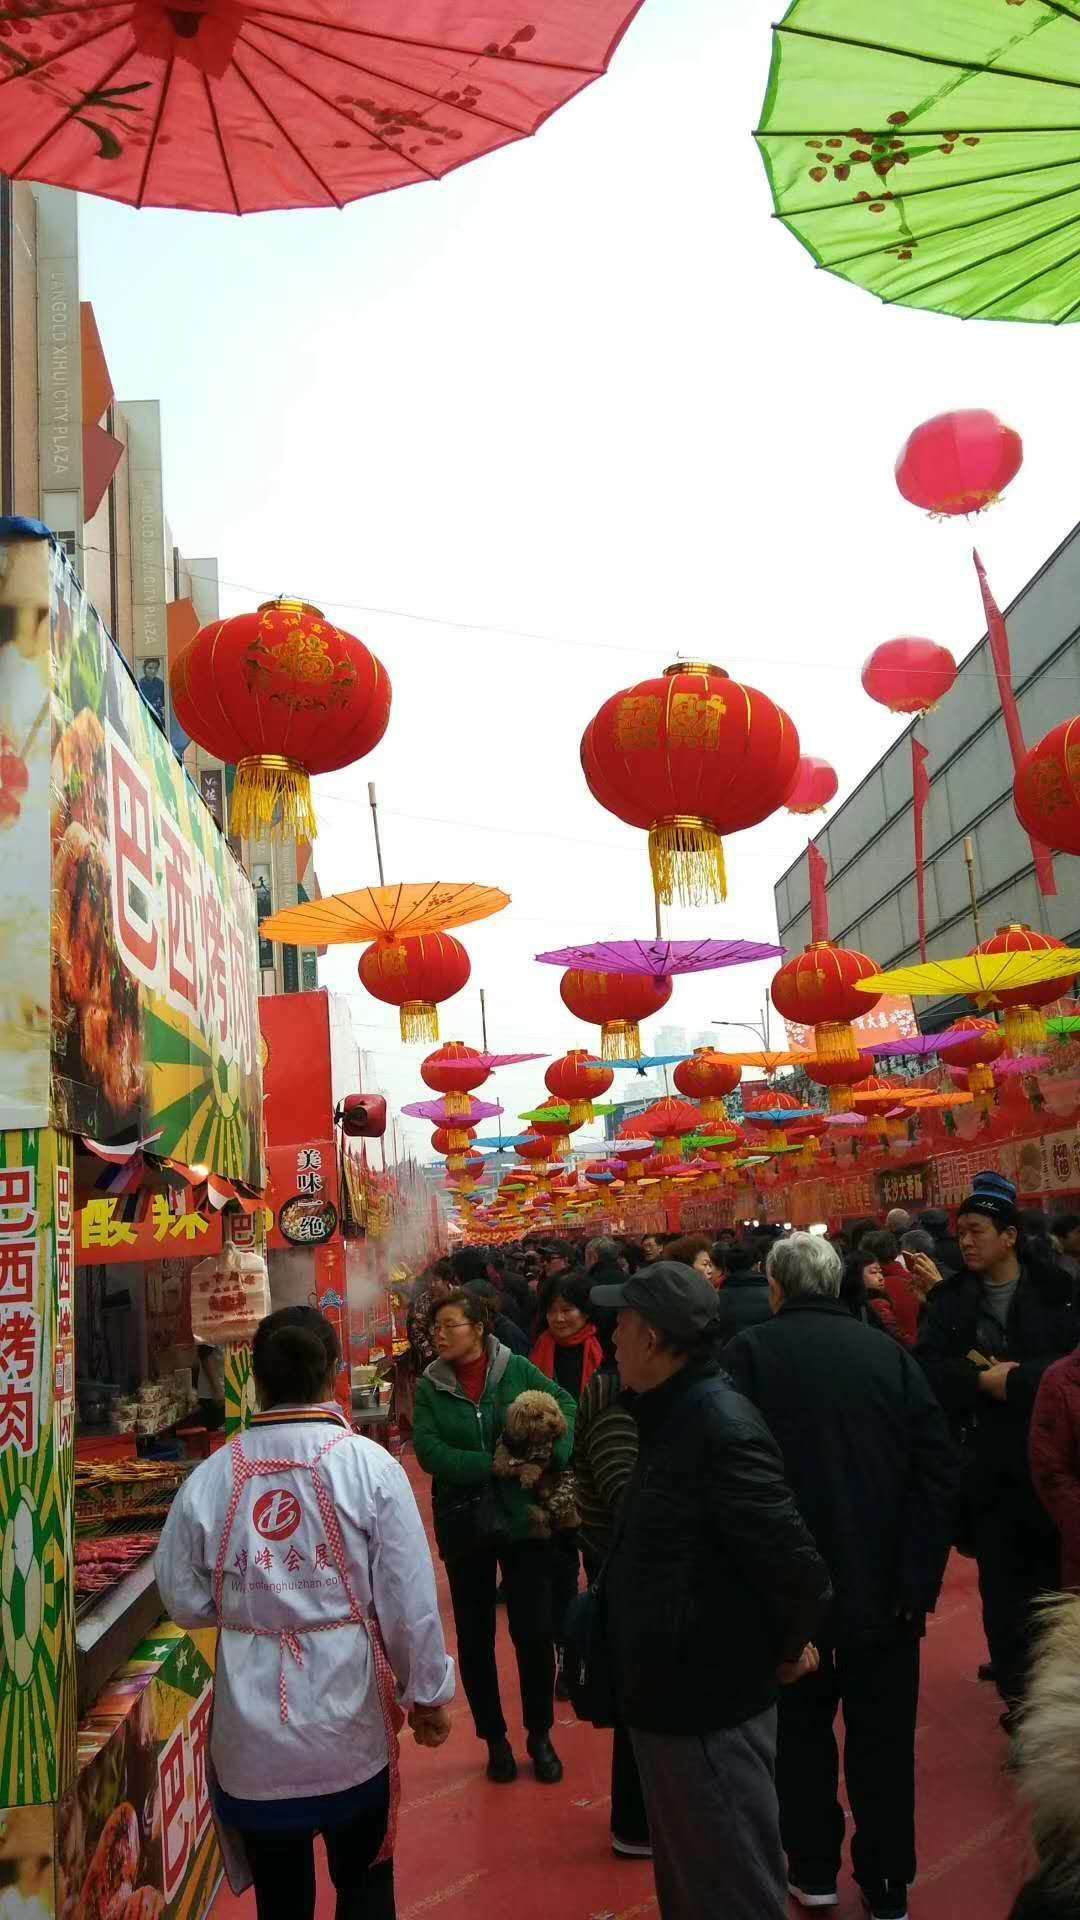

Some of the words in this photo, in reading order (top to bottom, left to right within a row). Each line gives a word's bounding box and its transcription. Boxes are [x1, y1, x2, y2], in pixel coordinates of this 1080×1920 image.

[51, 272, 68, 342] LANGOLD
[53, 345, 69, 387] XIHUI
[53, 389, 69, 423] CITY
[54, 425, 70, 475] PLAZA
[110, 742, 252, 1076] 巴西烤肉
[296, 1148, 325, 1240] 美味一绝
[0, 1170, 34, 1451] 巴西烤肉
